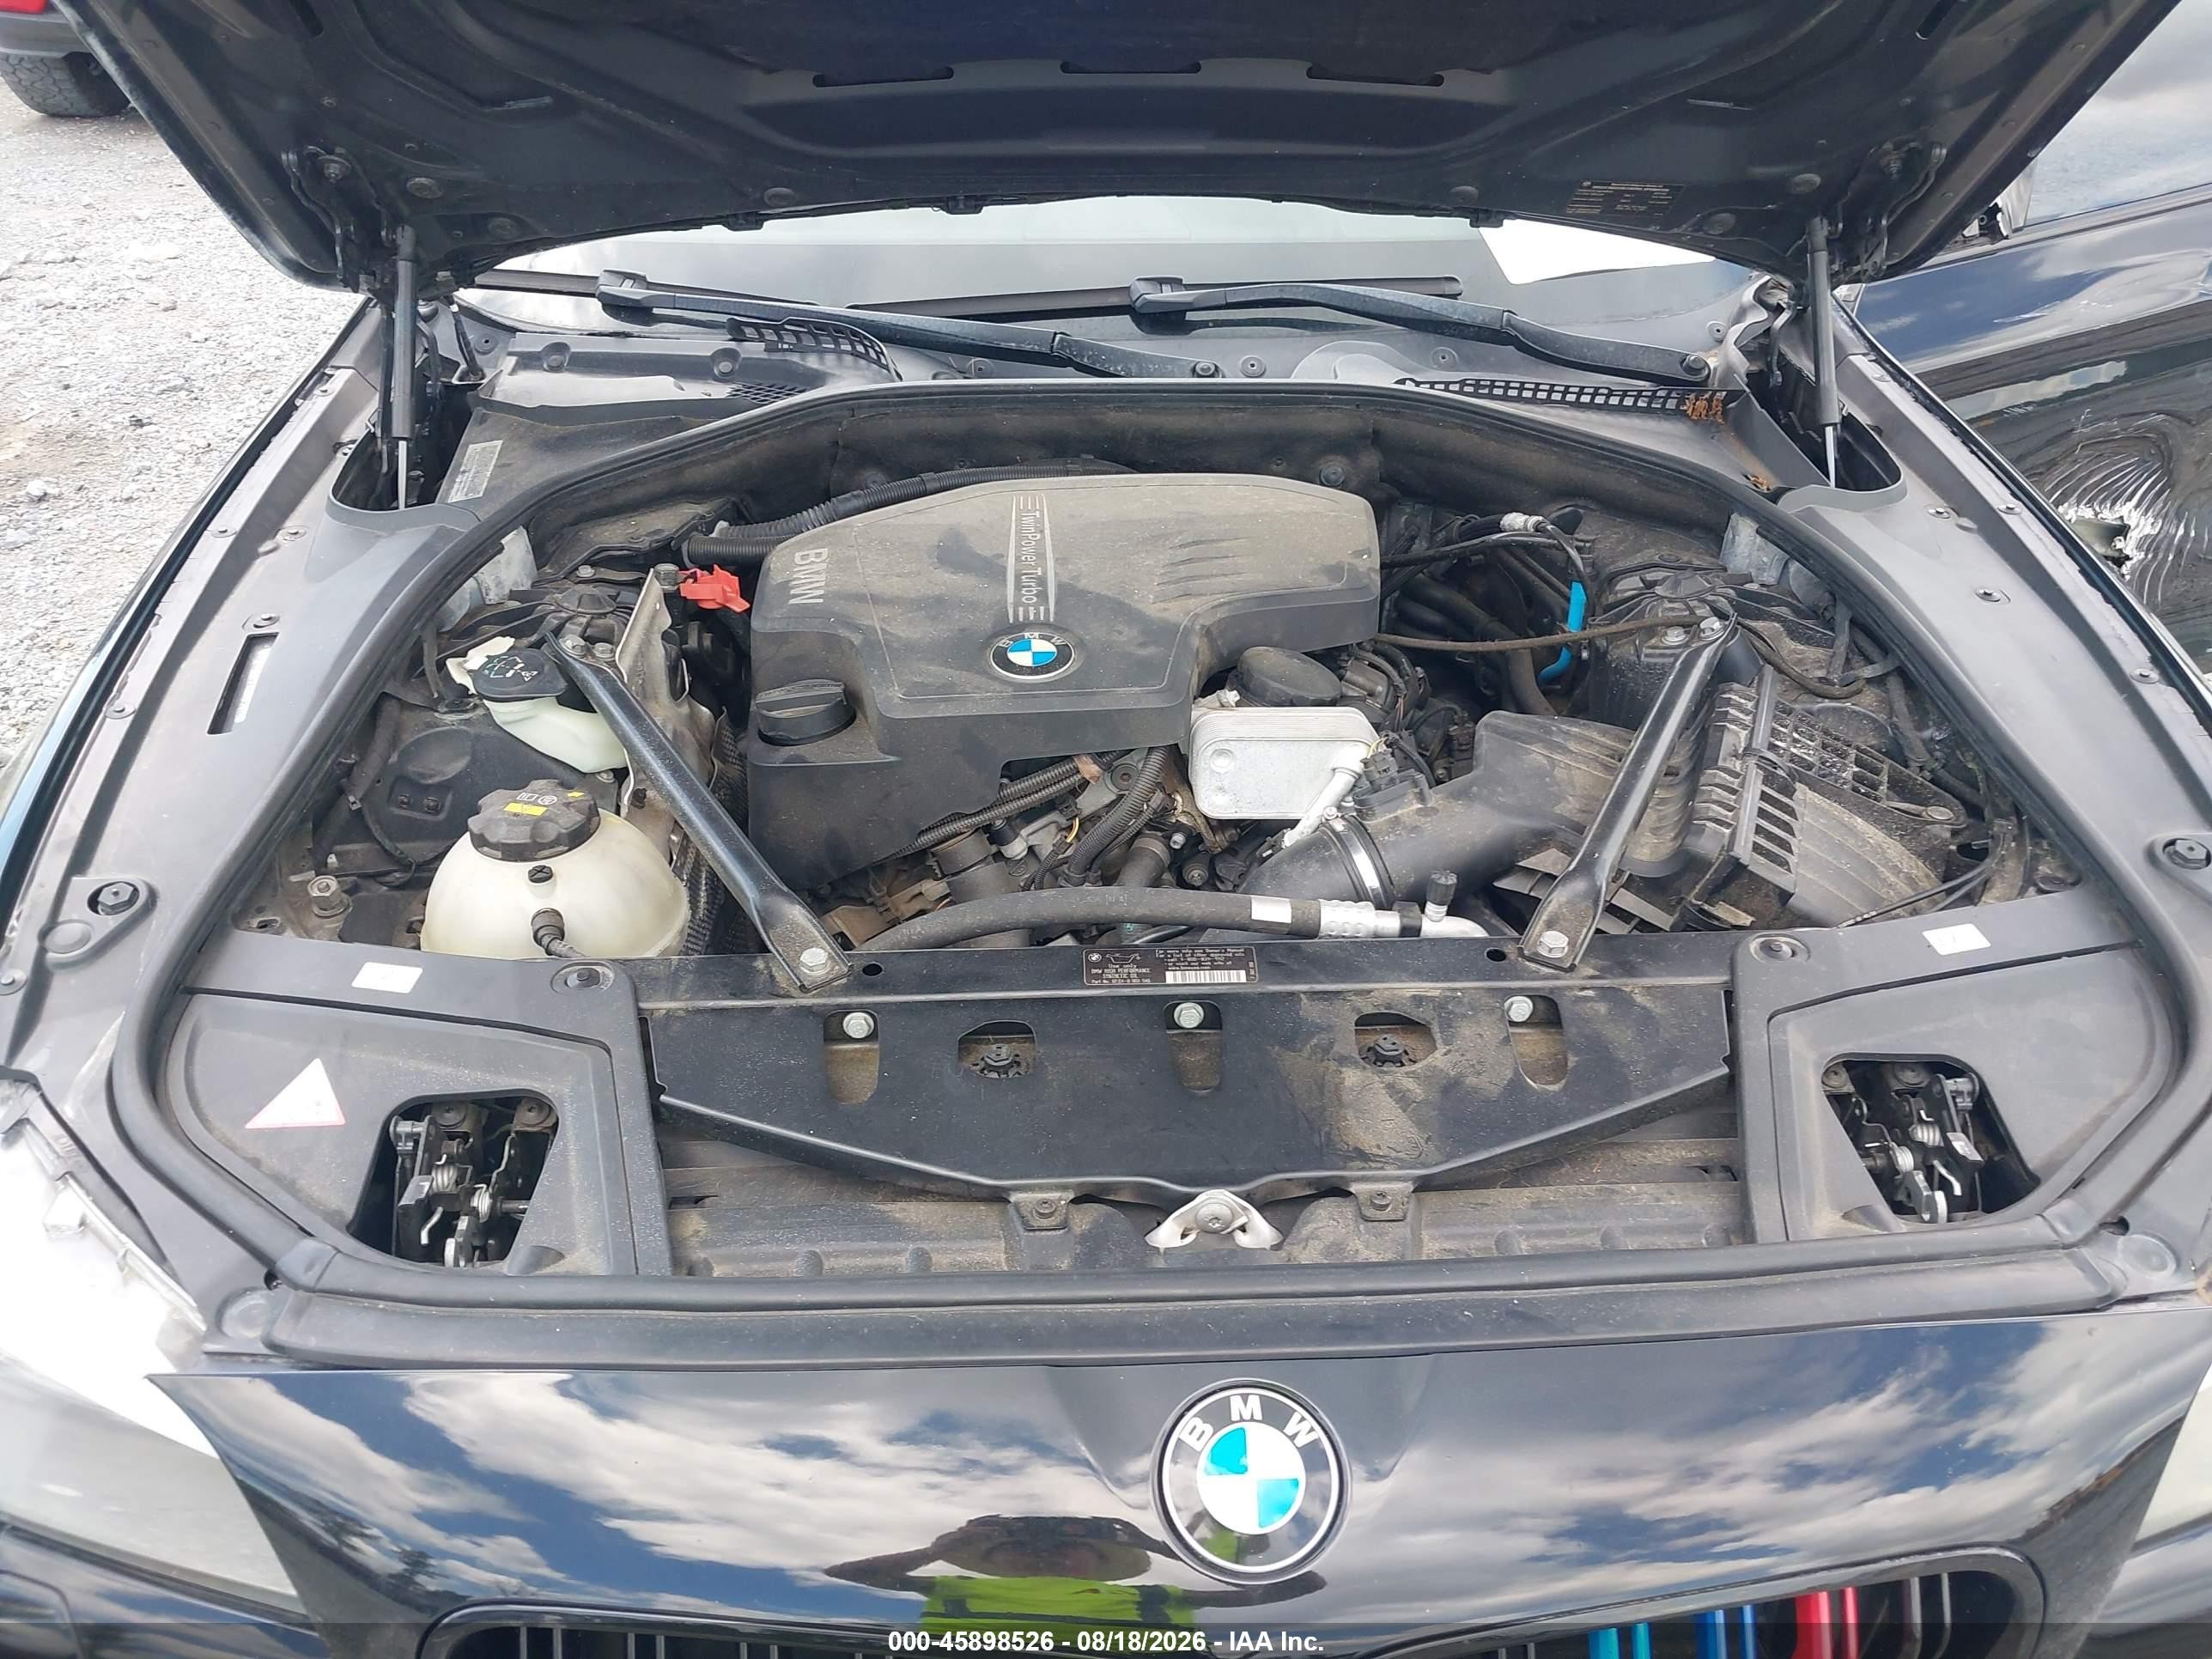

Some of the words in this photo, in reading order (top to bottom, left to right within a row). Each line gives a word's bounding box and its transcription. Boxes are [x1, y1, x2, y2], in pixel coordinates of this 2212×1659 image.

[1020, 510, 1041, 565] TwinPower
[788, 548, 829, 605] BMW
[1020, 567, 1043, 604] Turbo
[999, 633, 1066, 647] BMW
[1178, 1394, 1319, 1452] BMW
